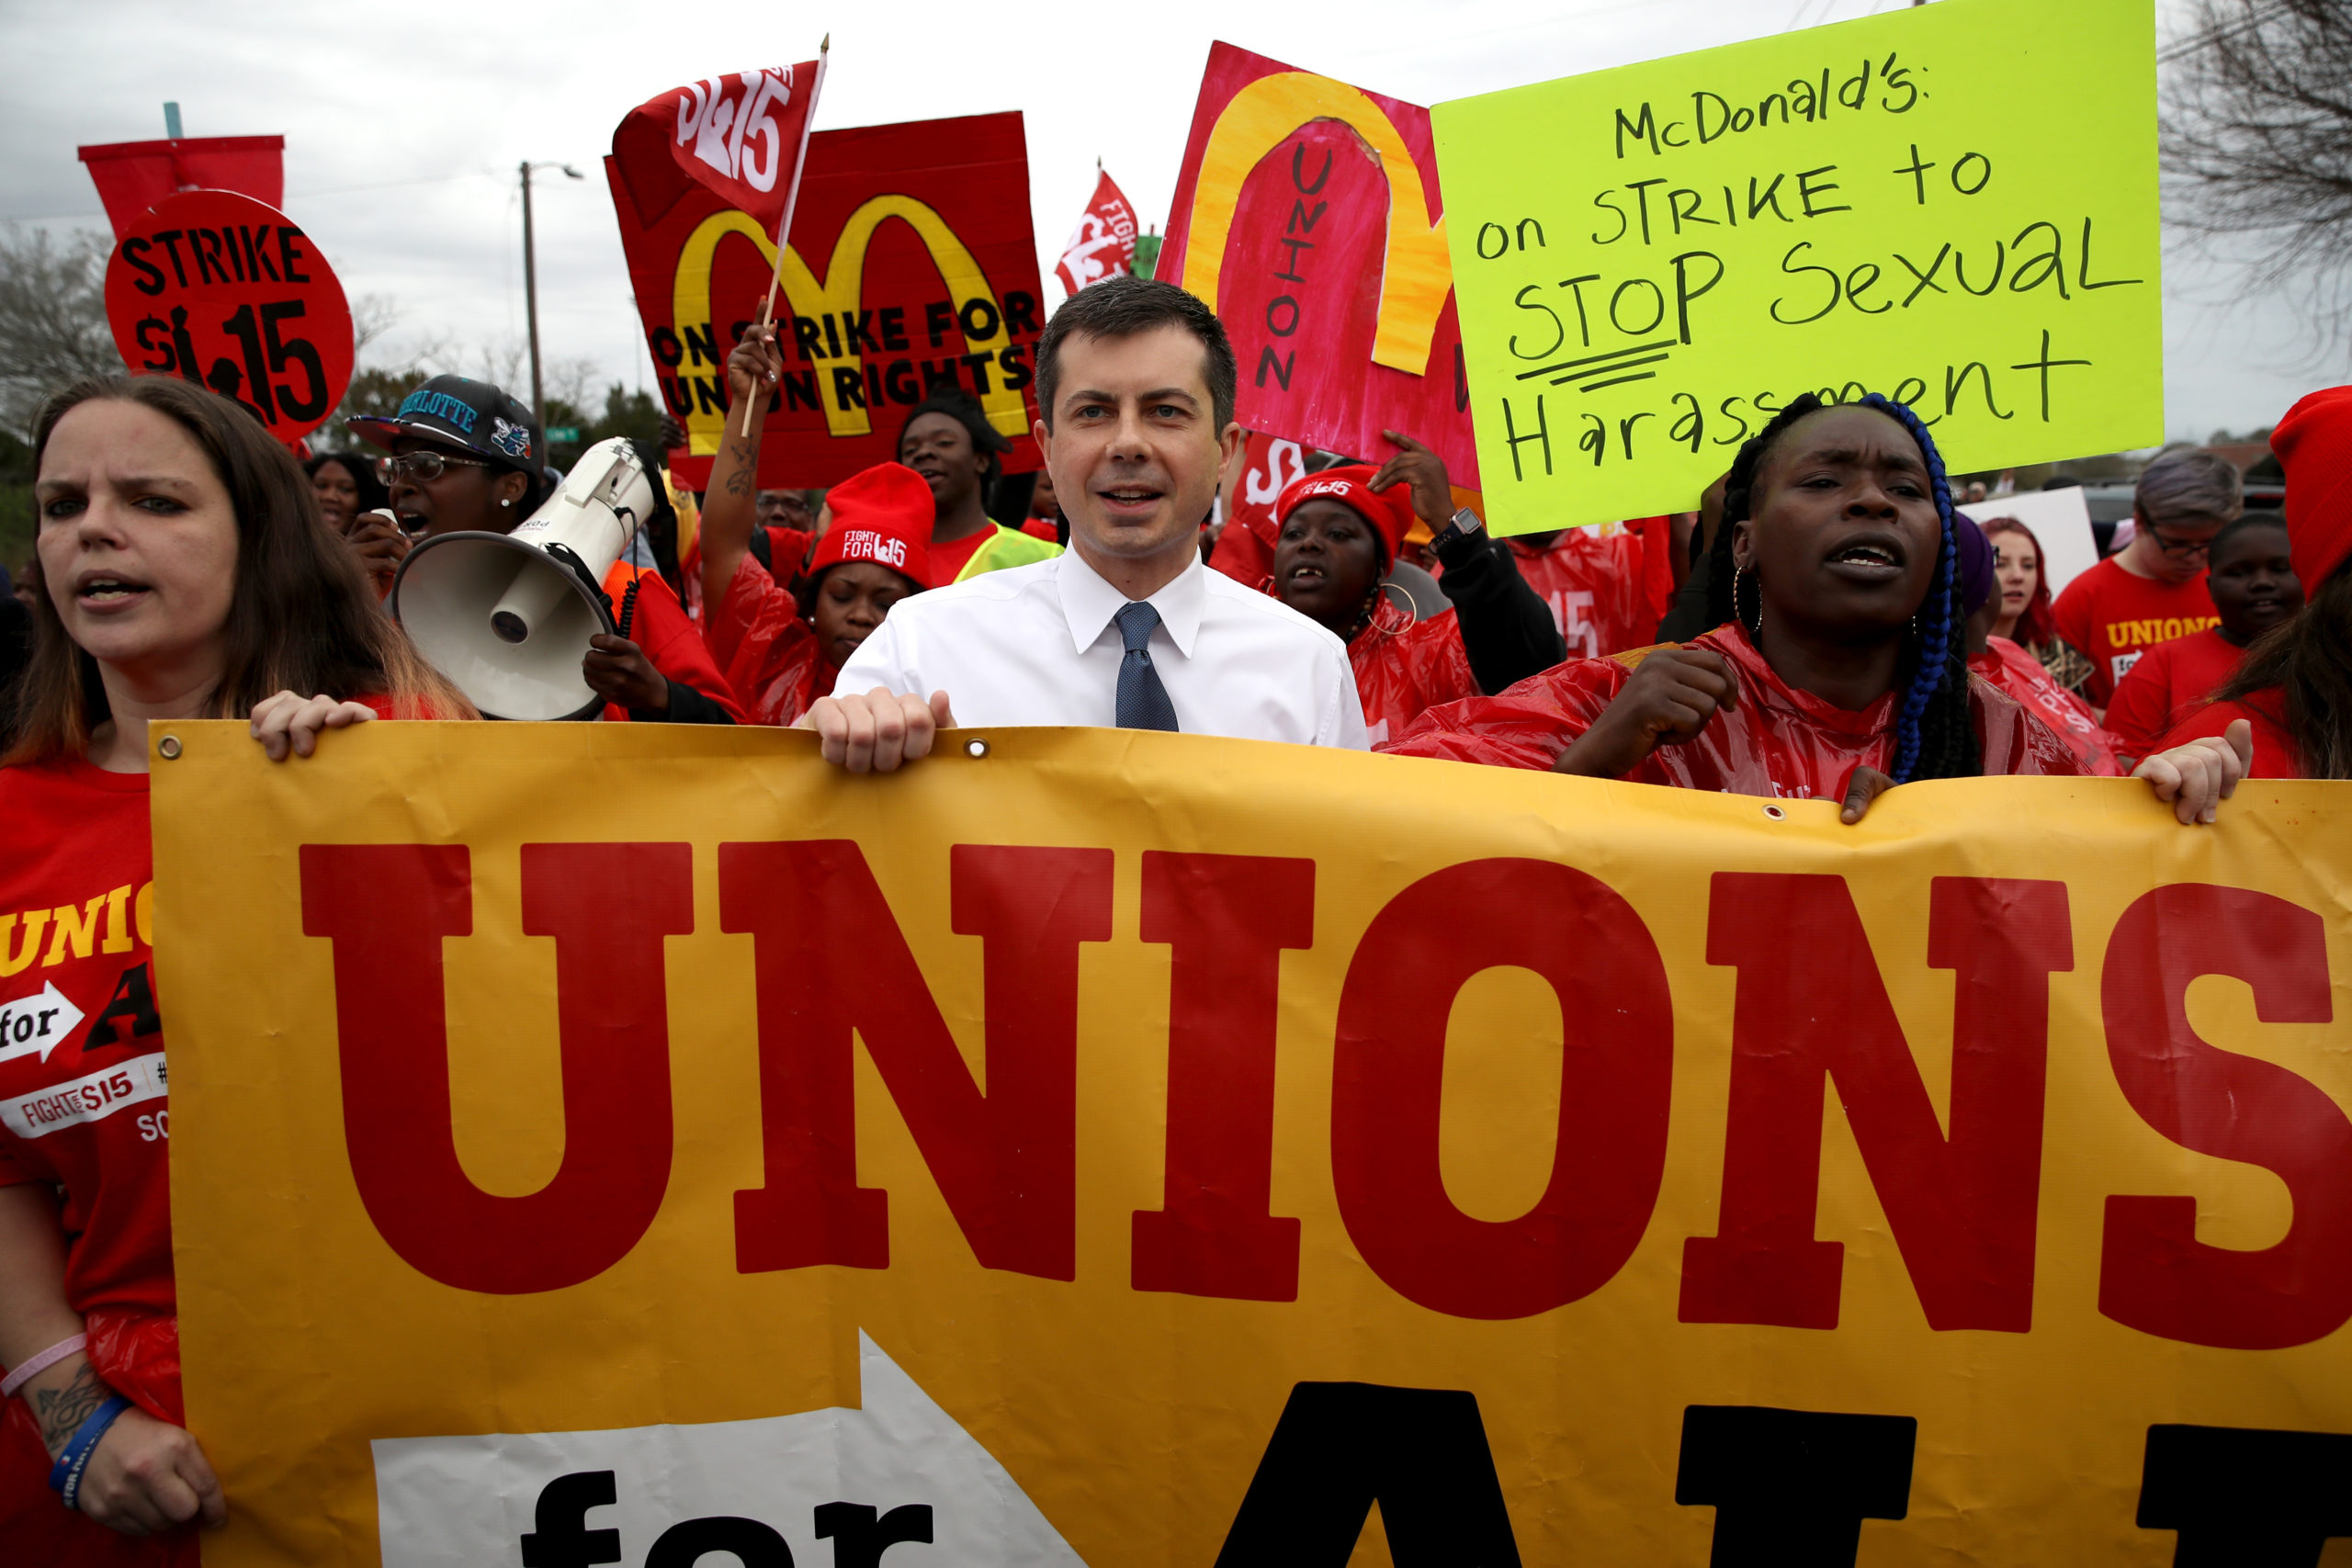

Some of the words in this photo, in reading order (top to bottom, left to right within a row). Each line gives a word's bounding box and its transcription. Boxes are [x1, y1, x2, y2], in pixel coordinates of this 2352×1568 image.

[1615, 52, 1929, 159] McDonald's:
[1476, 218, 1545, 260] on
[1591, 165, 1852, 246] STRIKE
[1893, 144, 1992, 206] to
[121, 225, 311, 297] STRIKE
[1255, 141, 1333, 392] UNION
[651, 322, 722, 367] ON
[924, 291, 1039, 347] FOR
[1509, 251, 1724, 360] STOP
[662, 370, 821, 417] UNN
[842, 541, 873, 558] FOR
[844, 530, 876, 543] FIGHT
[0, 1008, 59, 1048] for
[21, 1089, 80, 1128] FIGHT
[81, 1070, 133, 1111] $15
[300, 839, 2352, 1350] UNIONS
